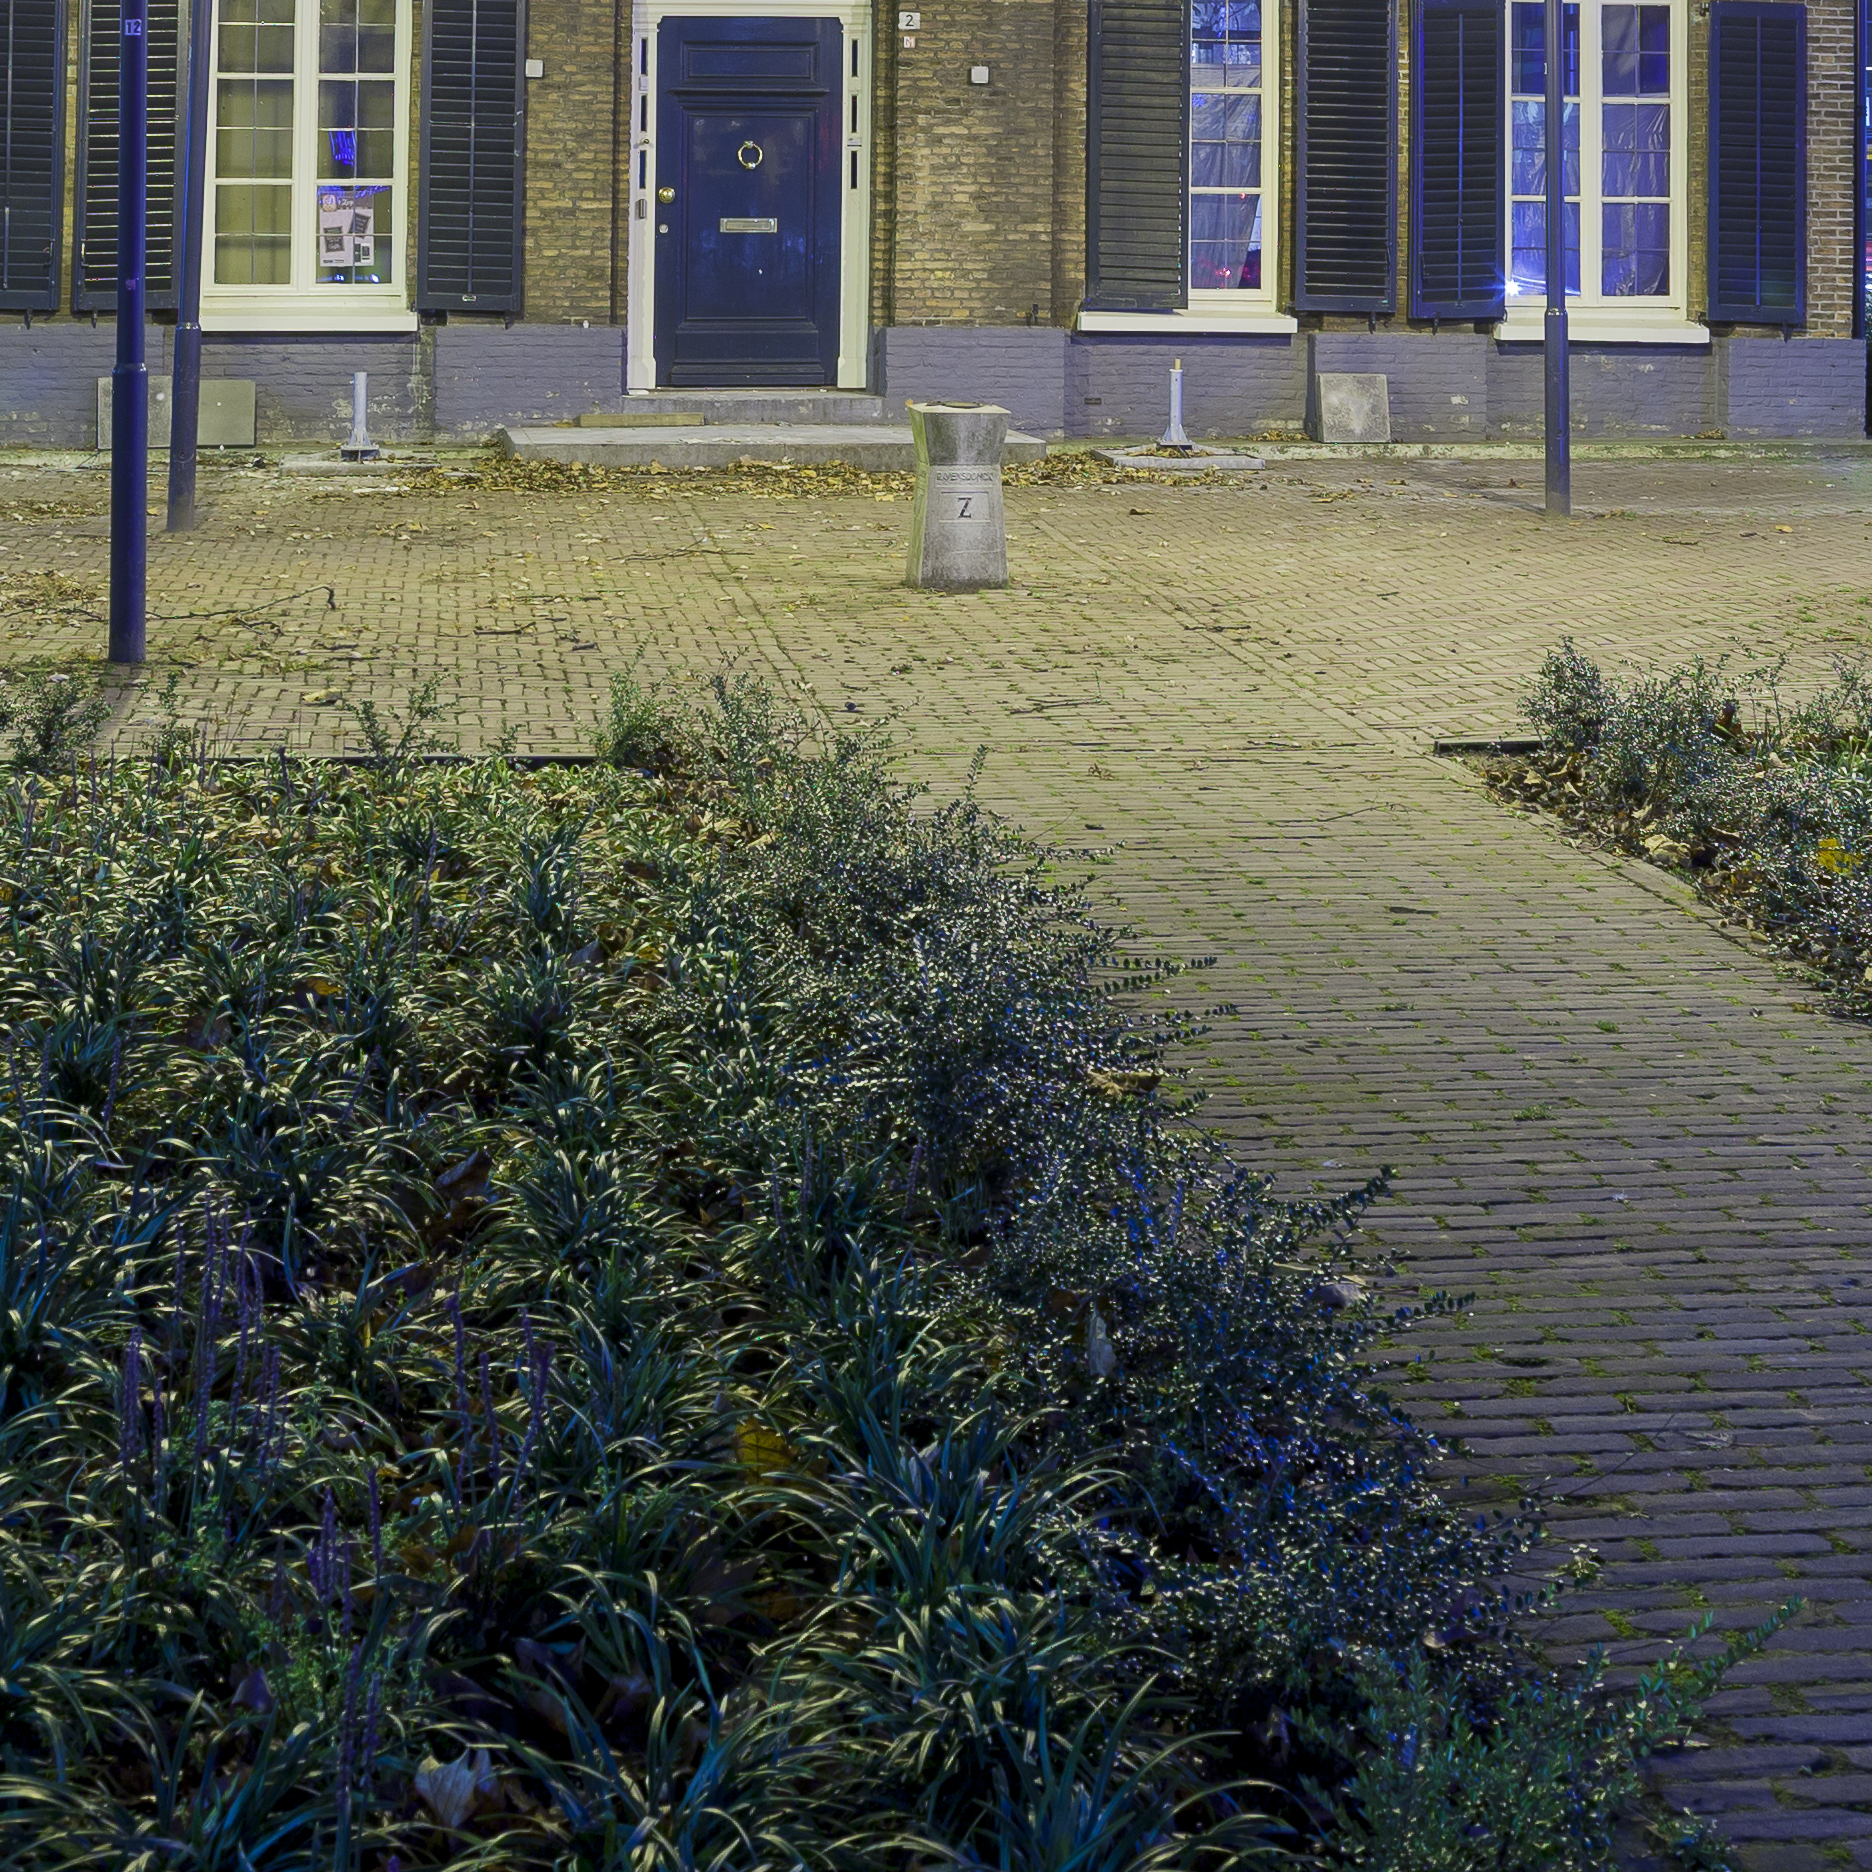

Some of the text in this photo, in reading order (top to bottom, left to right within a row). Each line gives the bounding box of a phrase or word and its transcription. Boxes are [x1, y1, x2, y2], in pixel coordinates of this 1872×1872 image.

[126, 20, 141, 34] 12
[905, 14, 914, 27] 2
[957, 497, 973, 519] Z
